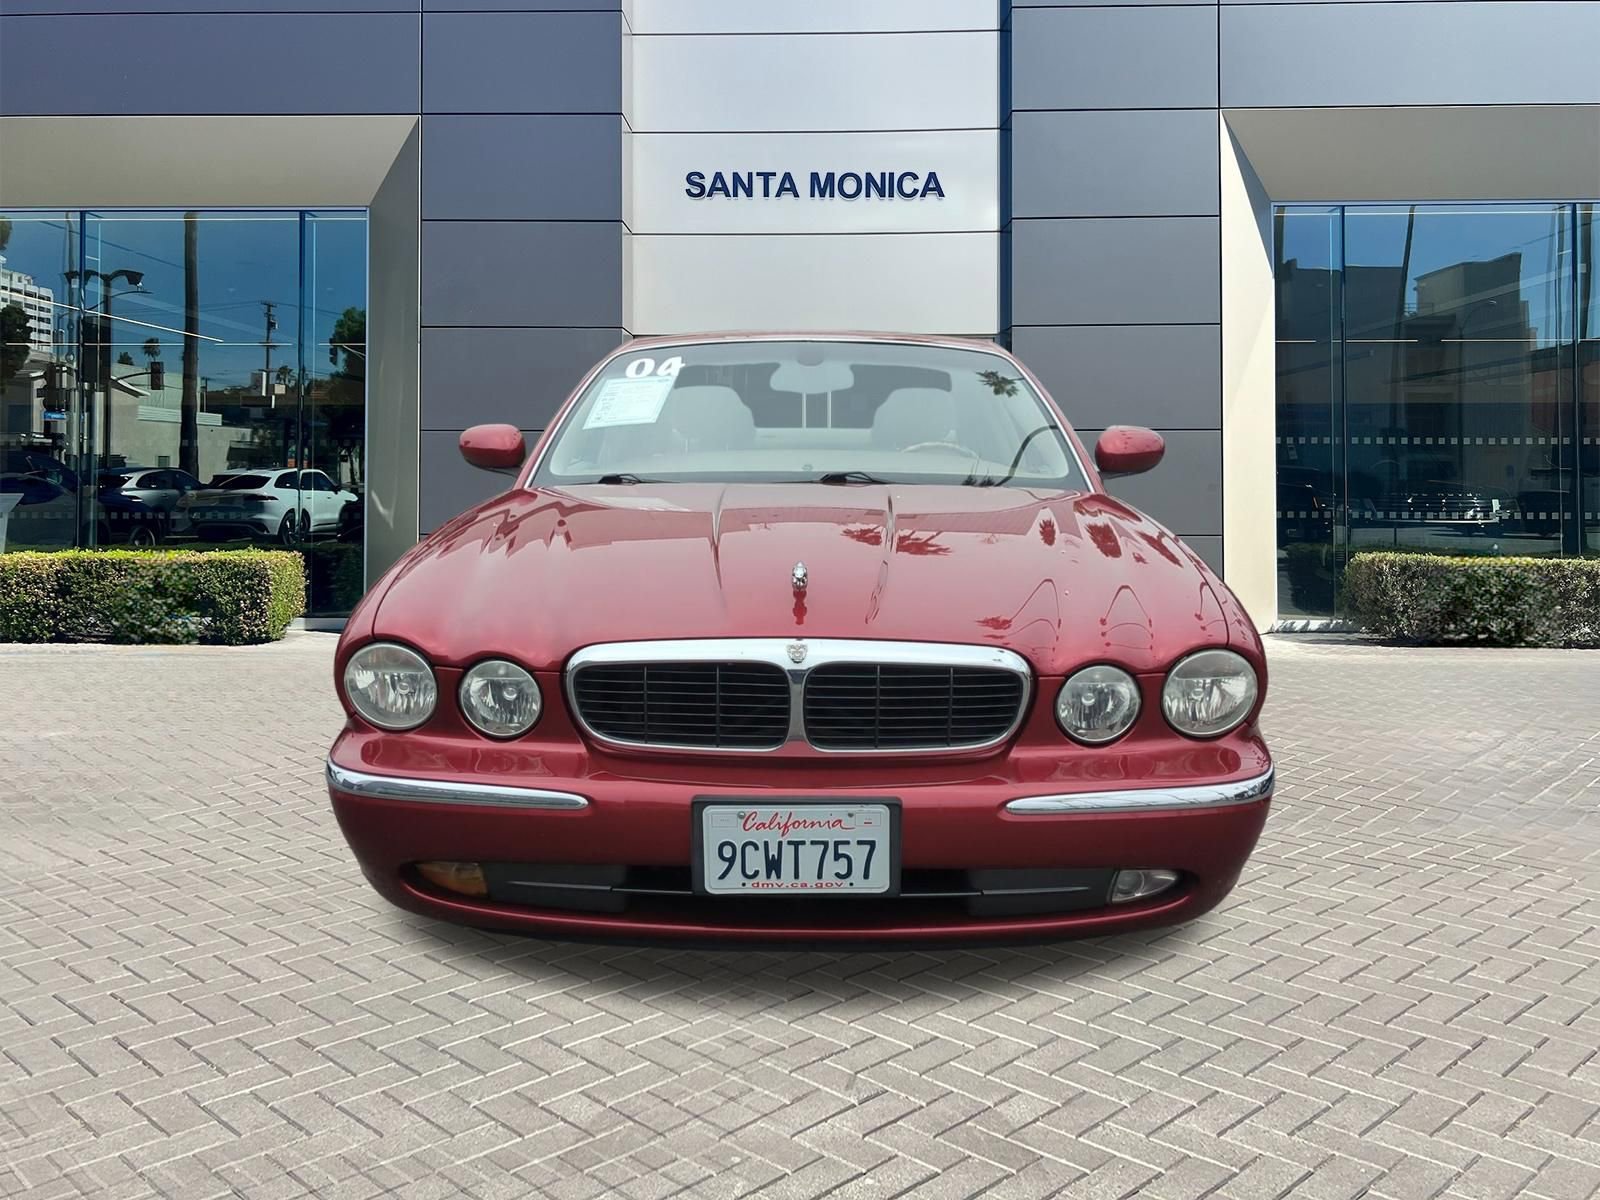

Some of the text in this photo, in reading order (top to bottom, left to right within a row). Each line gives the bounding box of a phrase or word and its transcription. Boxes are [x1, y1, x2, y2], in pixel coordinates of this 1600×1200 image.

[685, 171, 946, 199] SANTA MONICA
[625, 356, 686, 379] 04
[742, 811, 855, 837] California
[717, 840, 877, 880] 9CWT757
[751, 880, 844, 889] dmv.ca.gov
